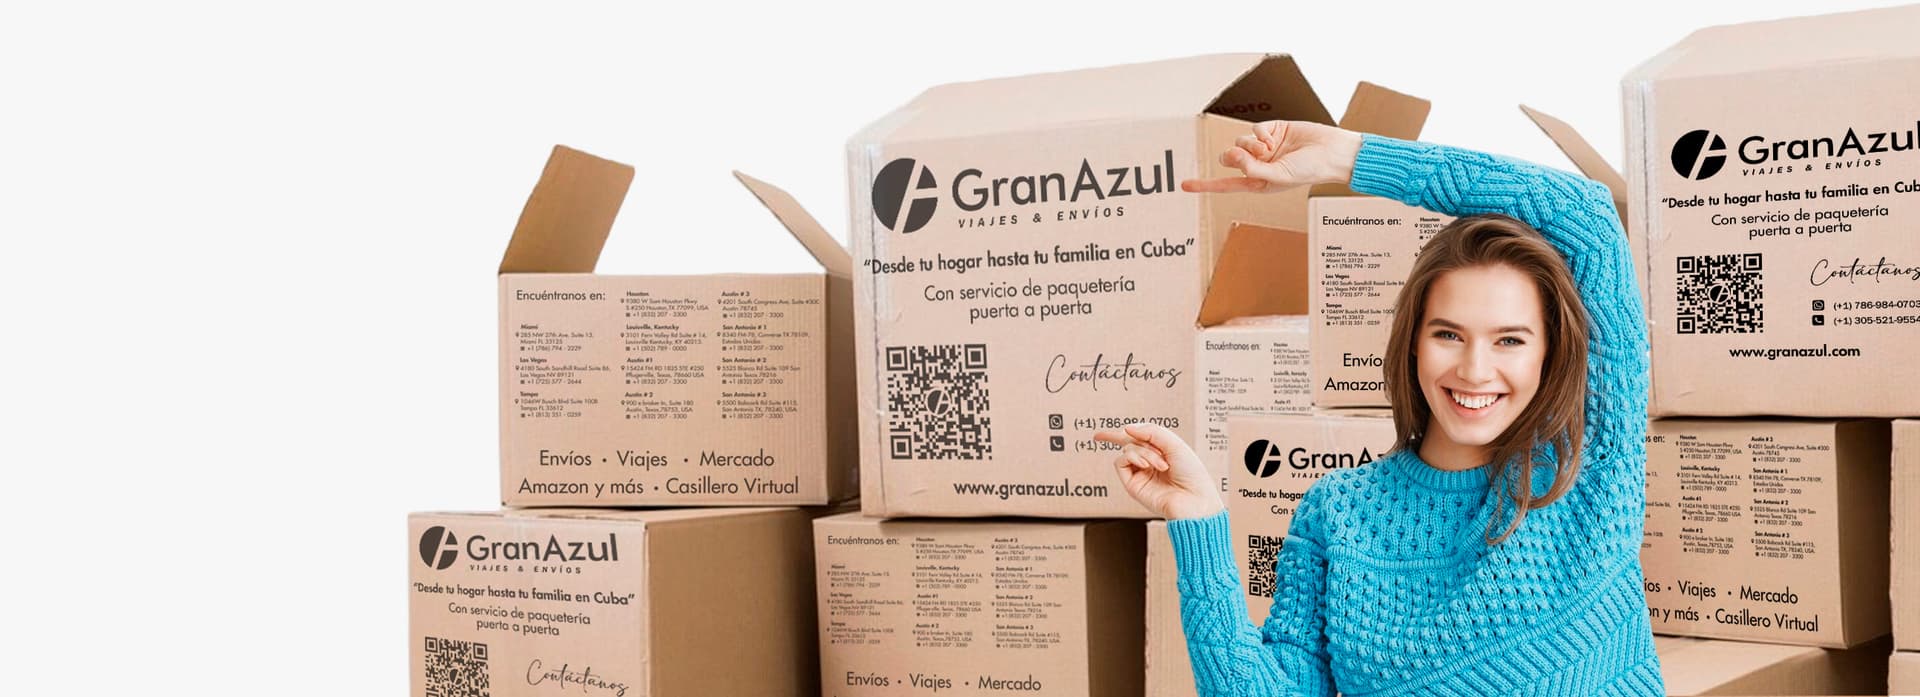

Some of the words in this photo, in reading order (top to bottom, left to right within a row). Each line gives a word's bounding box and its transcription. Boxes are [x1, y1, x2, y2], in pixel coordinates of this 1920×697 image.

[1738, 121, 1920, 164] GranAzul
[1743, 166, 1792, 176] VIAJES
[1825, 159, 1881, 170] ENVÍOS
[952, 150, 1175, 211] GranAzul
[1662, 195, 1704, 208] “Desde
[1709, 196, 1719, 206] tu
[1724, 193, 1761, 206] hogar
[1765, 190, 1800, 202] hasta
[1805, 190, 1817, 199] tu
[1822, 184, 1868, 198] familia
[1873, 186, 1889, 194] en
[1895, 179, 1920, 193] Cub
[959, 215, 1017, 228] VIAJES
[1033, 213, 1041, 223] &
[1057, 206, 1123, 221] ENVÍOS
[1323, 216, 1384, 225] Encuéntranos
[1712, 214, 1736, 225] Con
[1741, 211, 1790, 224] servicio
[1794, 208, 1810, 221] de
[1815, 205, 1888, 224] paquetería
[1749, 226, 1790, 240] puerta
[1809, 221, 1851, 237] puerta
[864, 258, 914, 275] “Desde
[920, 258, 933, 271] tu
[938, 253, 982, 274] hogar
[987, 250, 1029, 267] hasta
[1034, 250, 1048, 264] tu
[1054, 243, 1110, 263] familia
[1116, 248, 1135, 259] en
[1141, 238, 1194, 258] Cuba”
[517, 290, 586, 300] Encuéntranos
[924, 285, 954, 301] Con
[960, 282, 1017, 300] servicio
[1022, 278, 1042, 296] de
[1048, 276, 1135, 301] paquetería
[970, 304, 1019, 324] puerta
[1024, 306, 1034, 317] a
[1040, 300, 1092, 321] puerta
[1834, 302, 1852, 311] (+1)
[1855, 300, 1920, 309] 786-984-0703
[1834, 317, 1852, 326] (+1)
[1855, 316, 1920, 324] 305-521-9554
[1343, 353, 1382, 367] Envío
[1729, 344, 1860, 360] www.granazul.com
[1046, 352, 1182, 393] Contáctanos
[1074, 418, 1096, 430] (+1)
[1074, 440, 1098, 452] (+1)
[540, 450, 591, 466] Envíos
[617, 450, 667, 471] Viajes
[700, 448, 774, 467] Mercado
[1288, 447, 1387, 468] GranA
[518, 478, 588, 494] Amazon
[595, 483, 604, 498] y
[611, 478, 643, 494] más
[666, 476, 738, 494] Casillero
[744, 475, 798, 494] Virtual
[953, 478, 1107, 500] www.granazul.com
[1271, 505, 1288, 515] Con
[467, 533, 618, 562] GranAzul
[828, 536, 883, 546] Encuéntranos
[886, 538, 900, 546] en:
[534, 565, 581, 574] ENVÍOS
[446, 585, 454, 594] tu
[457, 584, 485, 598] hogar
[488, 585, 516, 598] hasta
[519, 589, 528, 599] tu
[532, 587, 571, 601] familia
[575, 594, 590, 602] en
[594, 592, 635, 605] Cuba”
[1644, 579, 1660, 592] íos
[1678, 580, 1716, 601] Viajes
[1740, 585, 1798, 604] Mercado
[448, 602, 467, 613] Con
[471, 606, 508, 617] servicio
[511, 606, 524, 619] de
[526, 612, 590, 630] paquetería
[1663, 609, 1670, 623] y
[1675, 607, 1699, 621] más
[1715, 608, 1771, 627] Casillero
[1775, 613, 1818, 632] Virtual
[477, 620, 509, 631] puerta
[512, 624, 519, 632] a
[523, 622, 559, 636] puerta
[527, 659, 629, 697] Contáctanos
[846, 671, 889, 686] Envíos
[909, 673, 951, 692] Viajes
[978, 674, 1041, 691] Mercado
